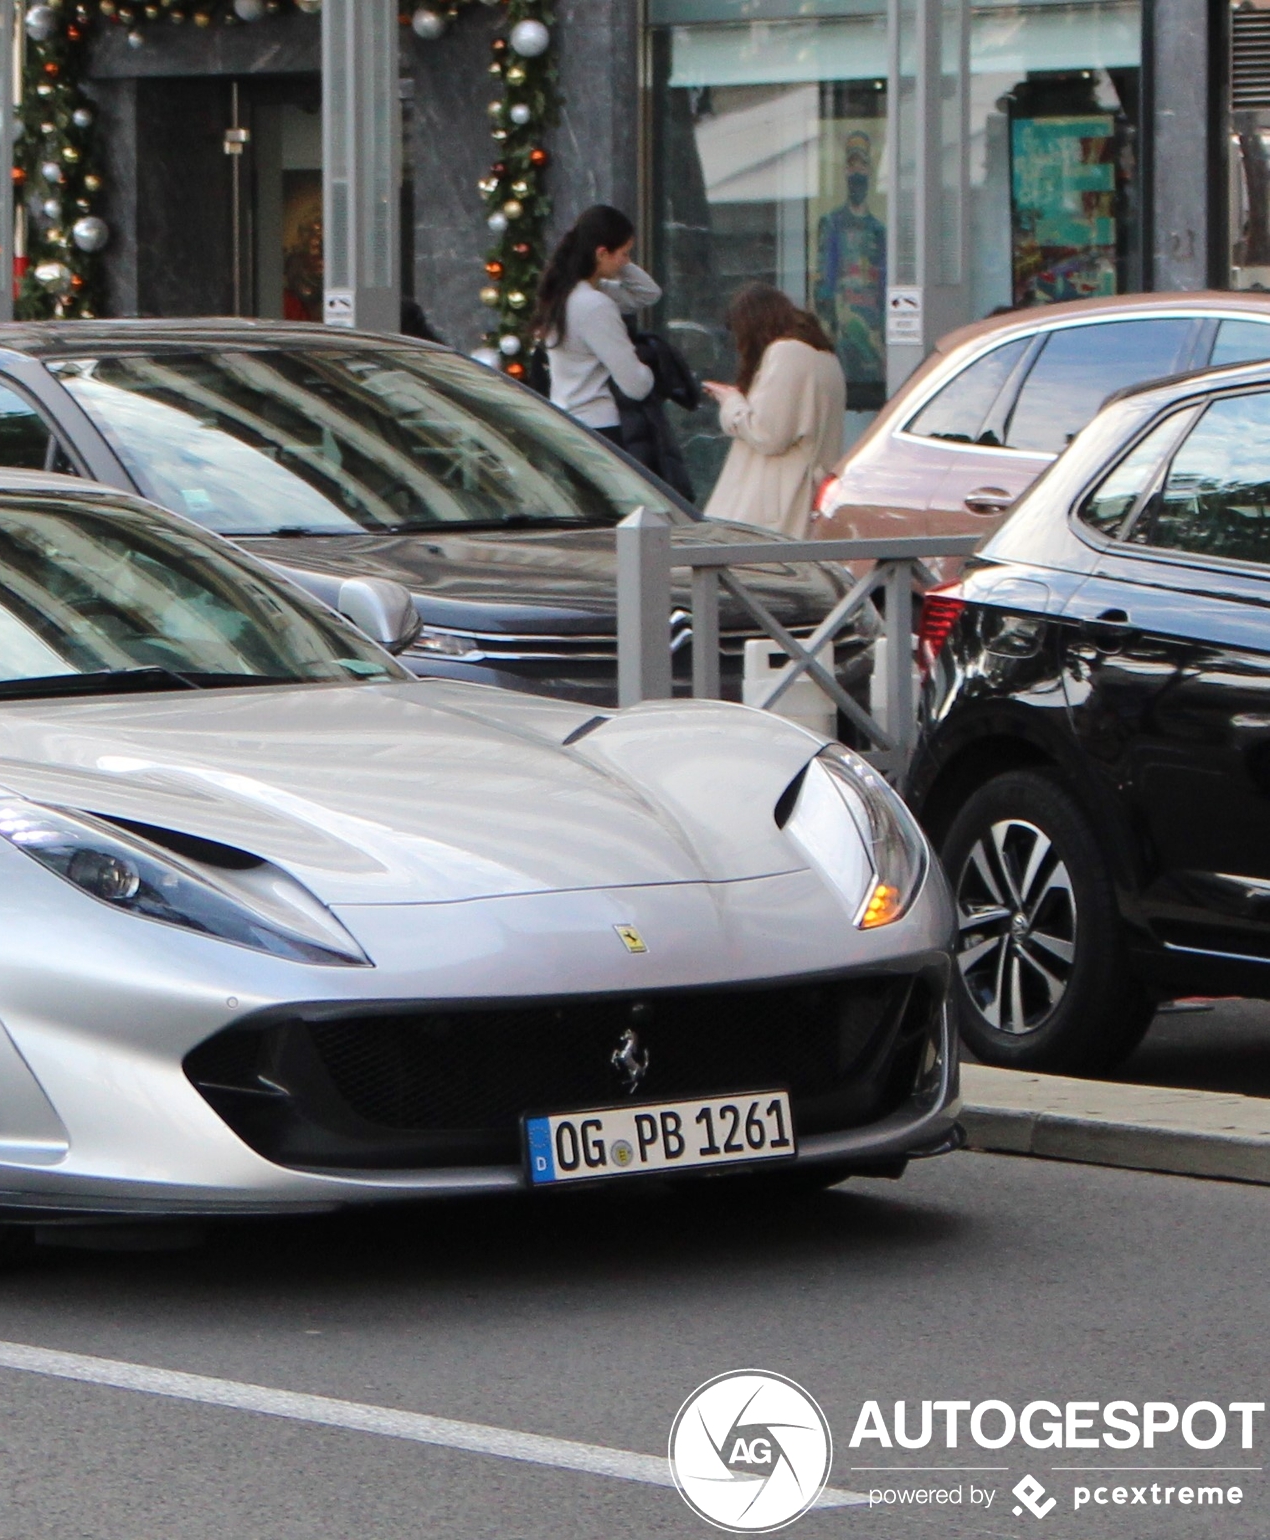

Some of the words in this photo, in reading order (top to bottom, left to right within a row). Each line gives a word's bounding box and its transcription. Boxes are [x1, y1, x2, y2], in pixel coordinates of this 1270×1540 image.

[556, 1119, 607, 1172] OG
[635, 1111, 685, 1162] PB
[696, 1099, 790, 1156] 1261
[536, 1156, 547, 1171] D
